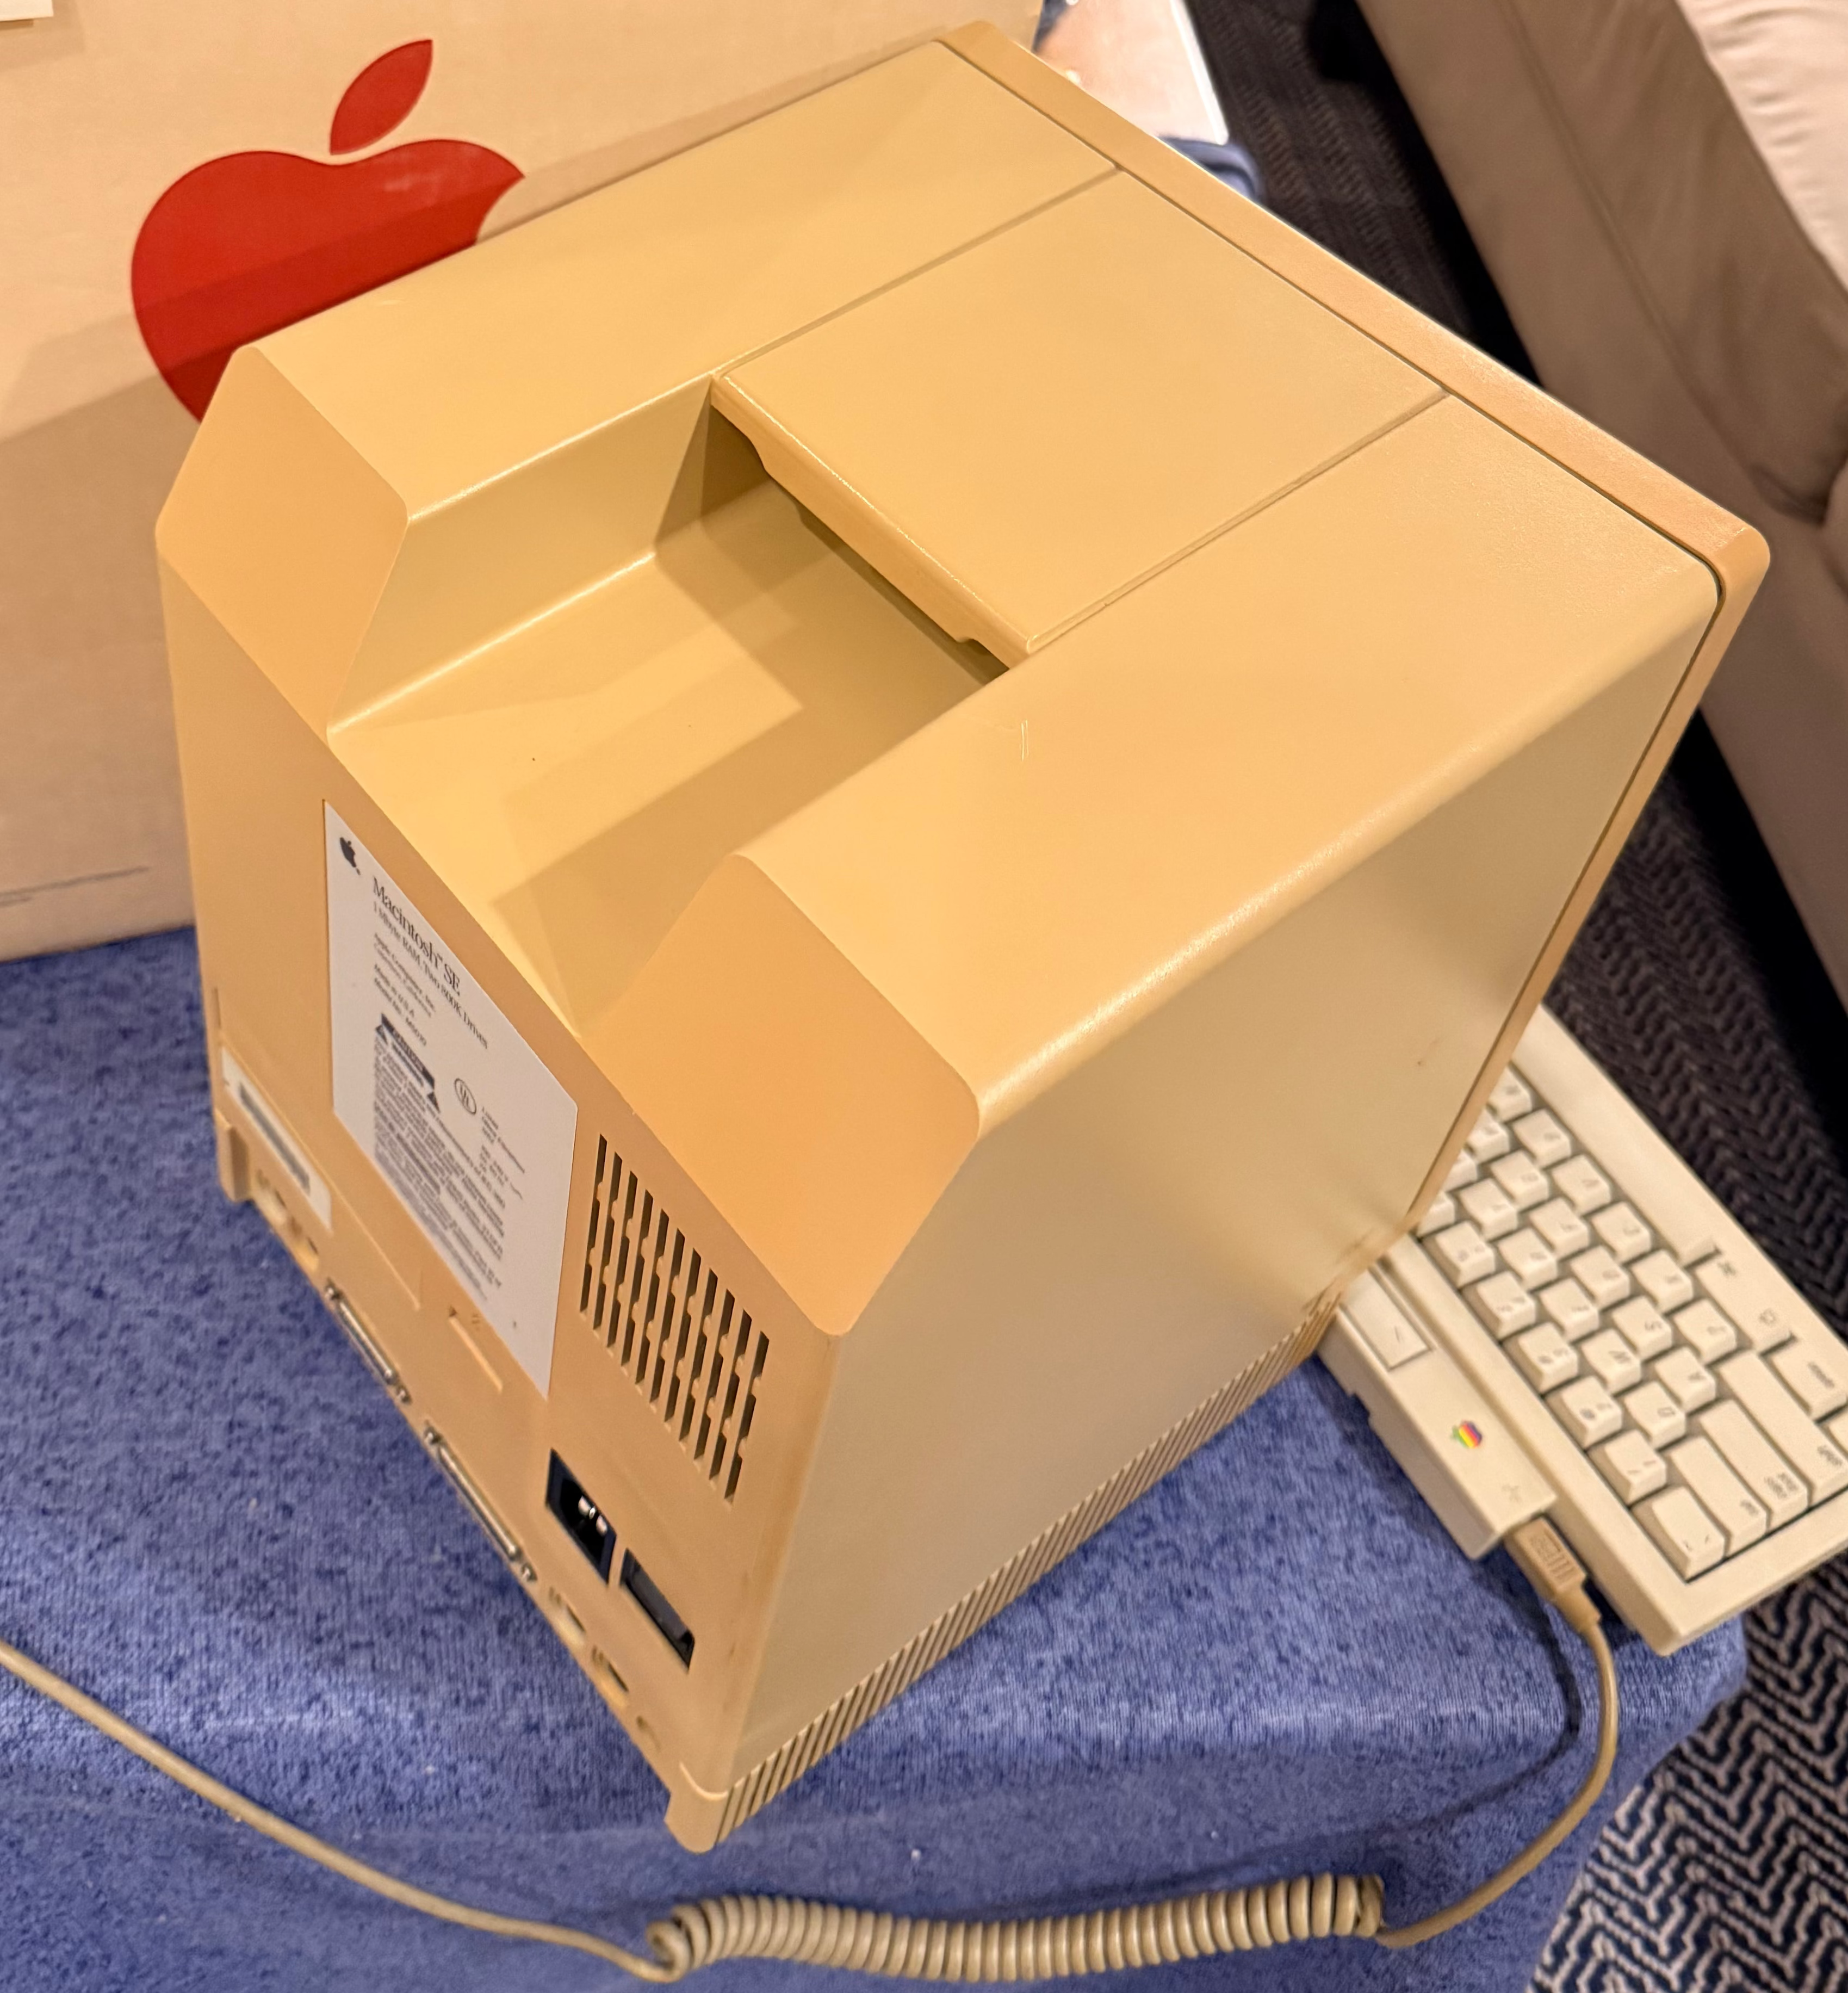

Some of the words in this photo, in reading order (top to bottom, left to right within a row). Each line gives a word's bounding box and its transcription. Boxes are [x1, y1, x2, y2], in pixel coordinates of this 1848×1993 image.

[422, 960, 439, 990] Two
[441, 983, 462, 1018] 800K
[463, 1011, 488, 1050] Drives
[443, 962, 461, 996] SE
